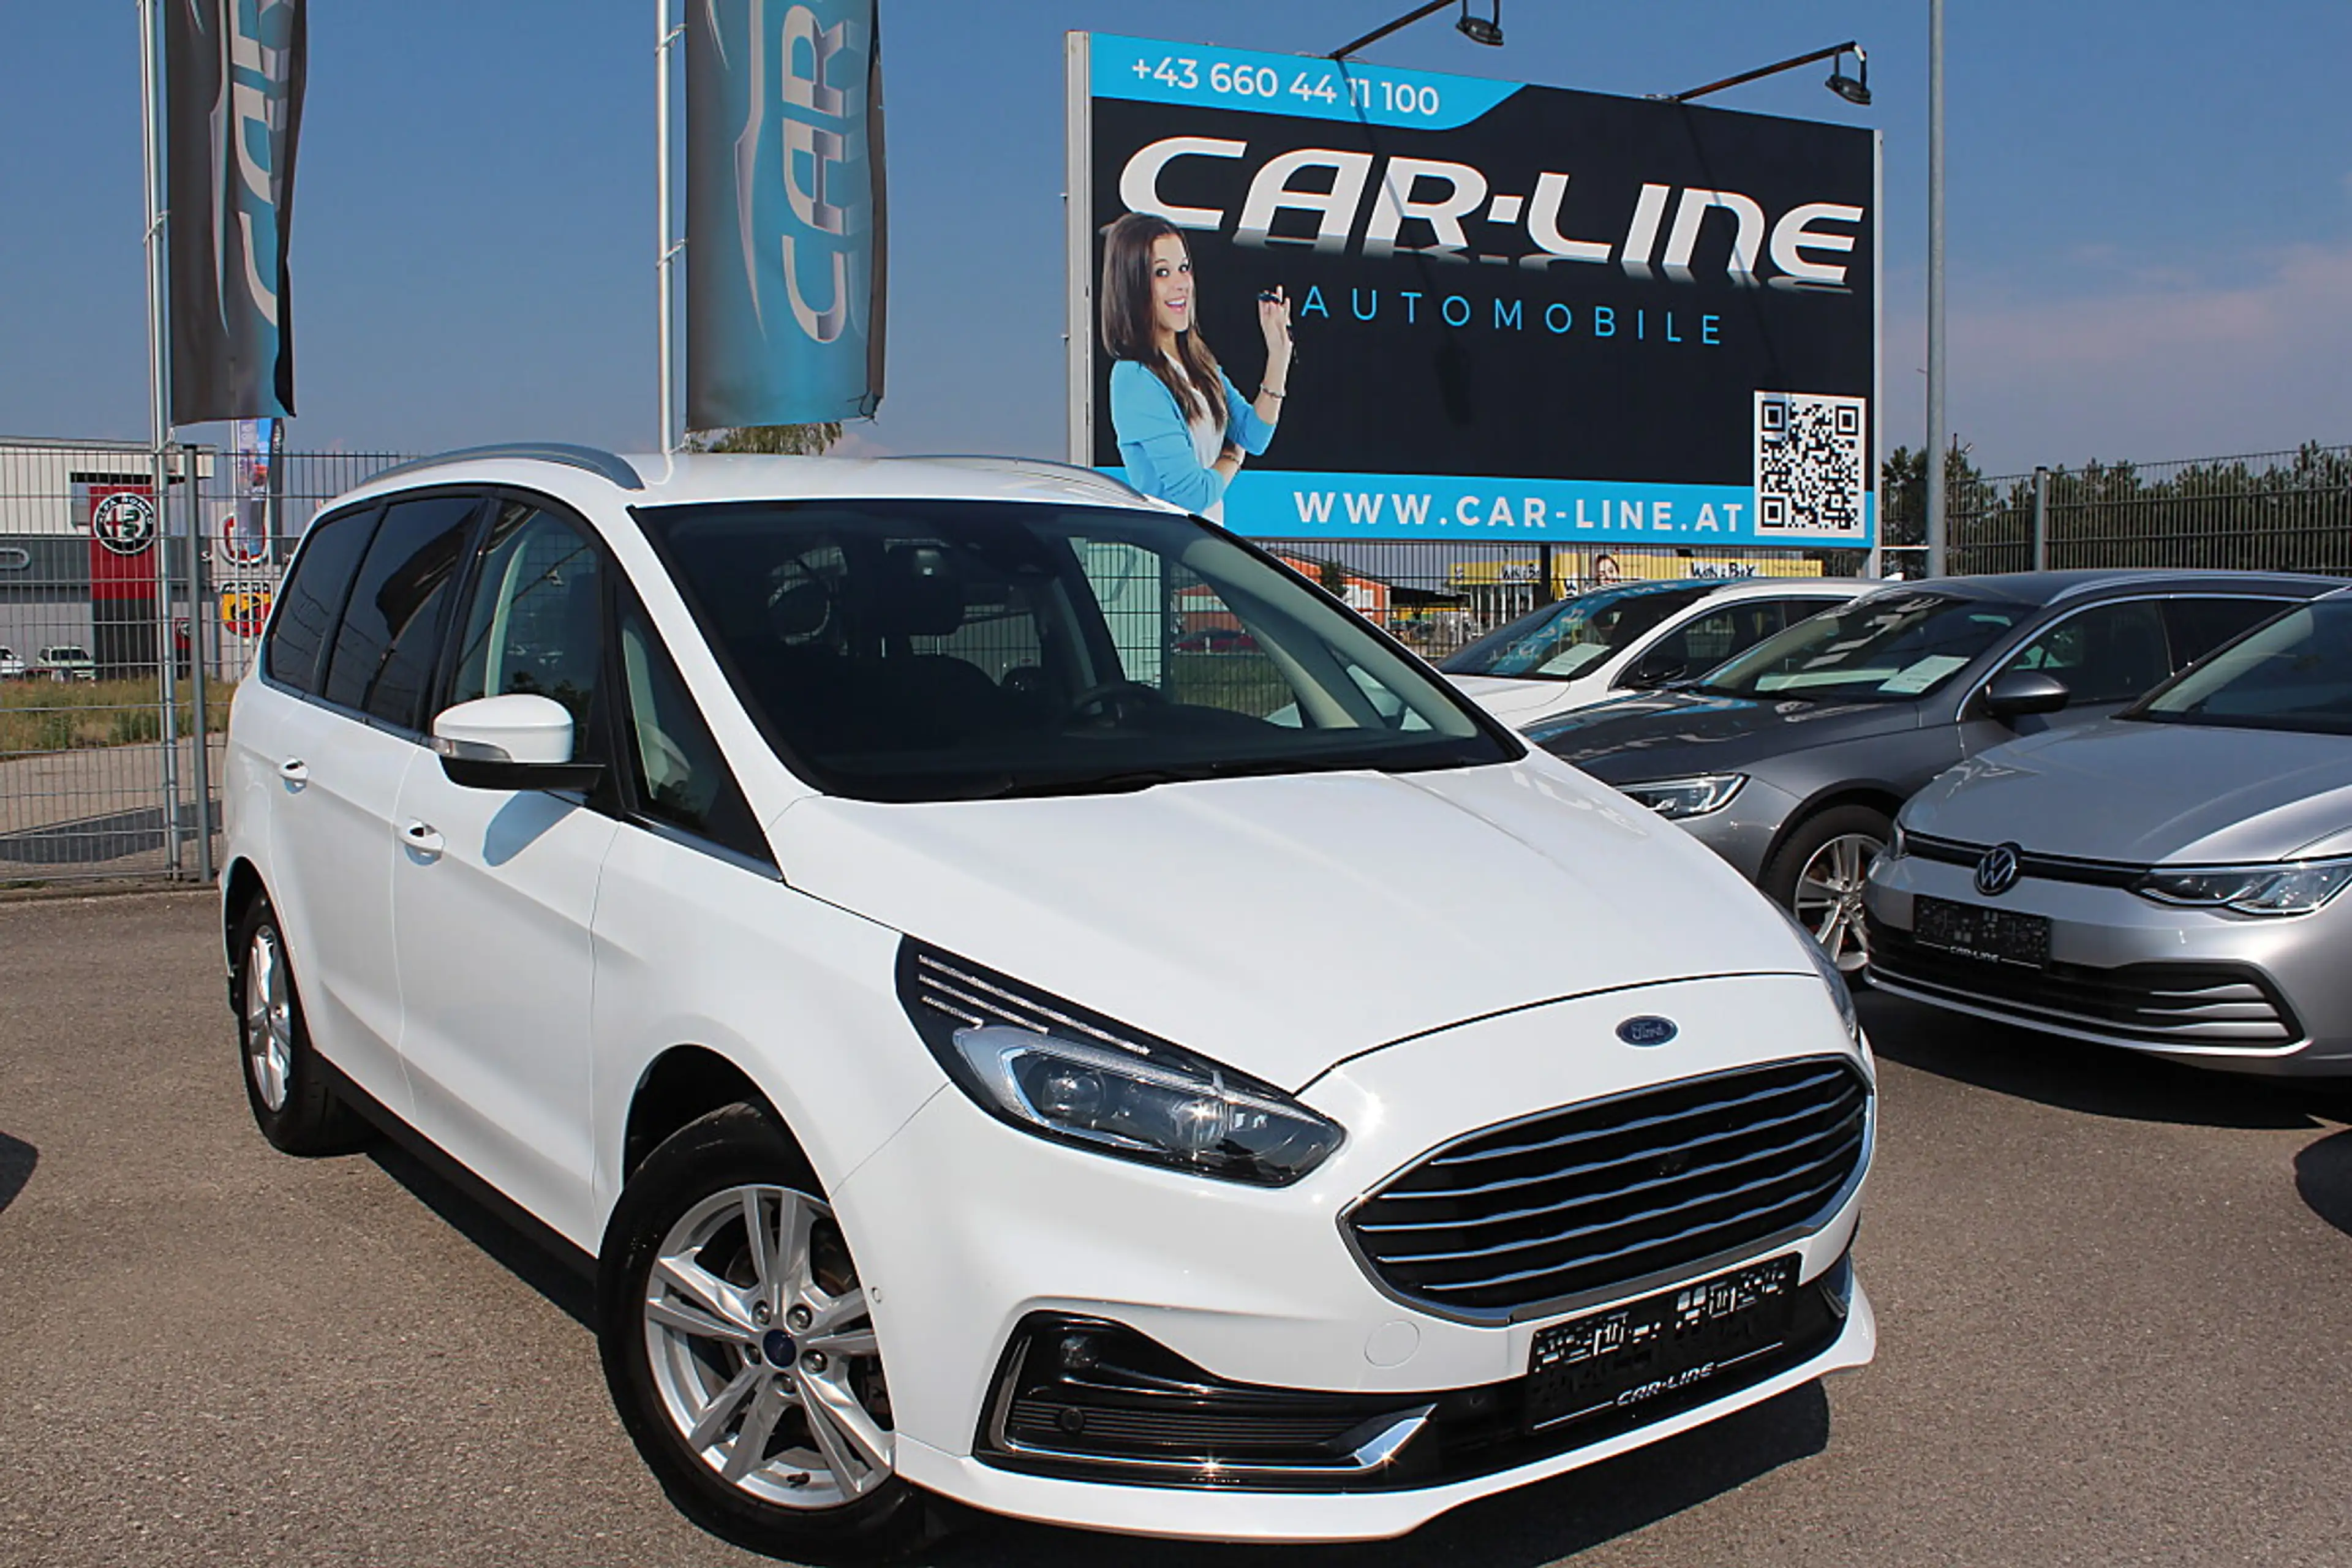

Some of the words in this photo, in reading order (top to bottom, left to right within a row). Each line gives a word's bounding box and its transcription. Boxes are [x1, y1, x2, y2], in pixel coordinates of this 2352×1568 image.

[1132, 56, 1199, 89] +43
[1210, 62, 1278, 97] 660
[1289, 72, 1338, 105] 44
[1349, 77, 1371, 109] 11
[1381, 81, 1441, 116] 100
[1118, 136, 1864, 284] CAR-LINE
[1301, 284, 1722, 345] AUTOMOBILE
[1293, 491, 1744, 532] WWW.CAR-LINE.AT
[1950, 945, 2000, 963] CAR-LINE
[1630, 1020, 1665, 1041] Ford
[1616, 1360, 1716, 1408] CAR-LINE
